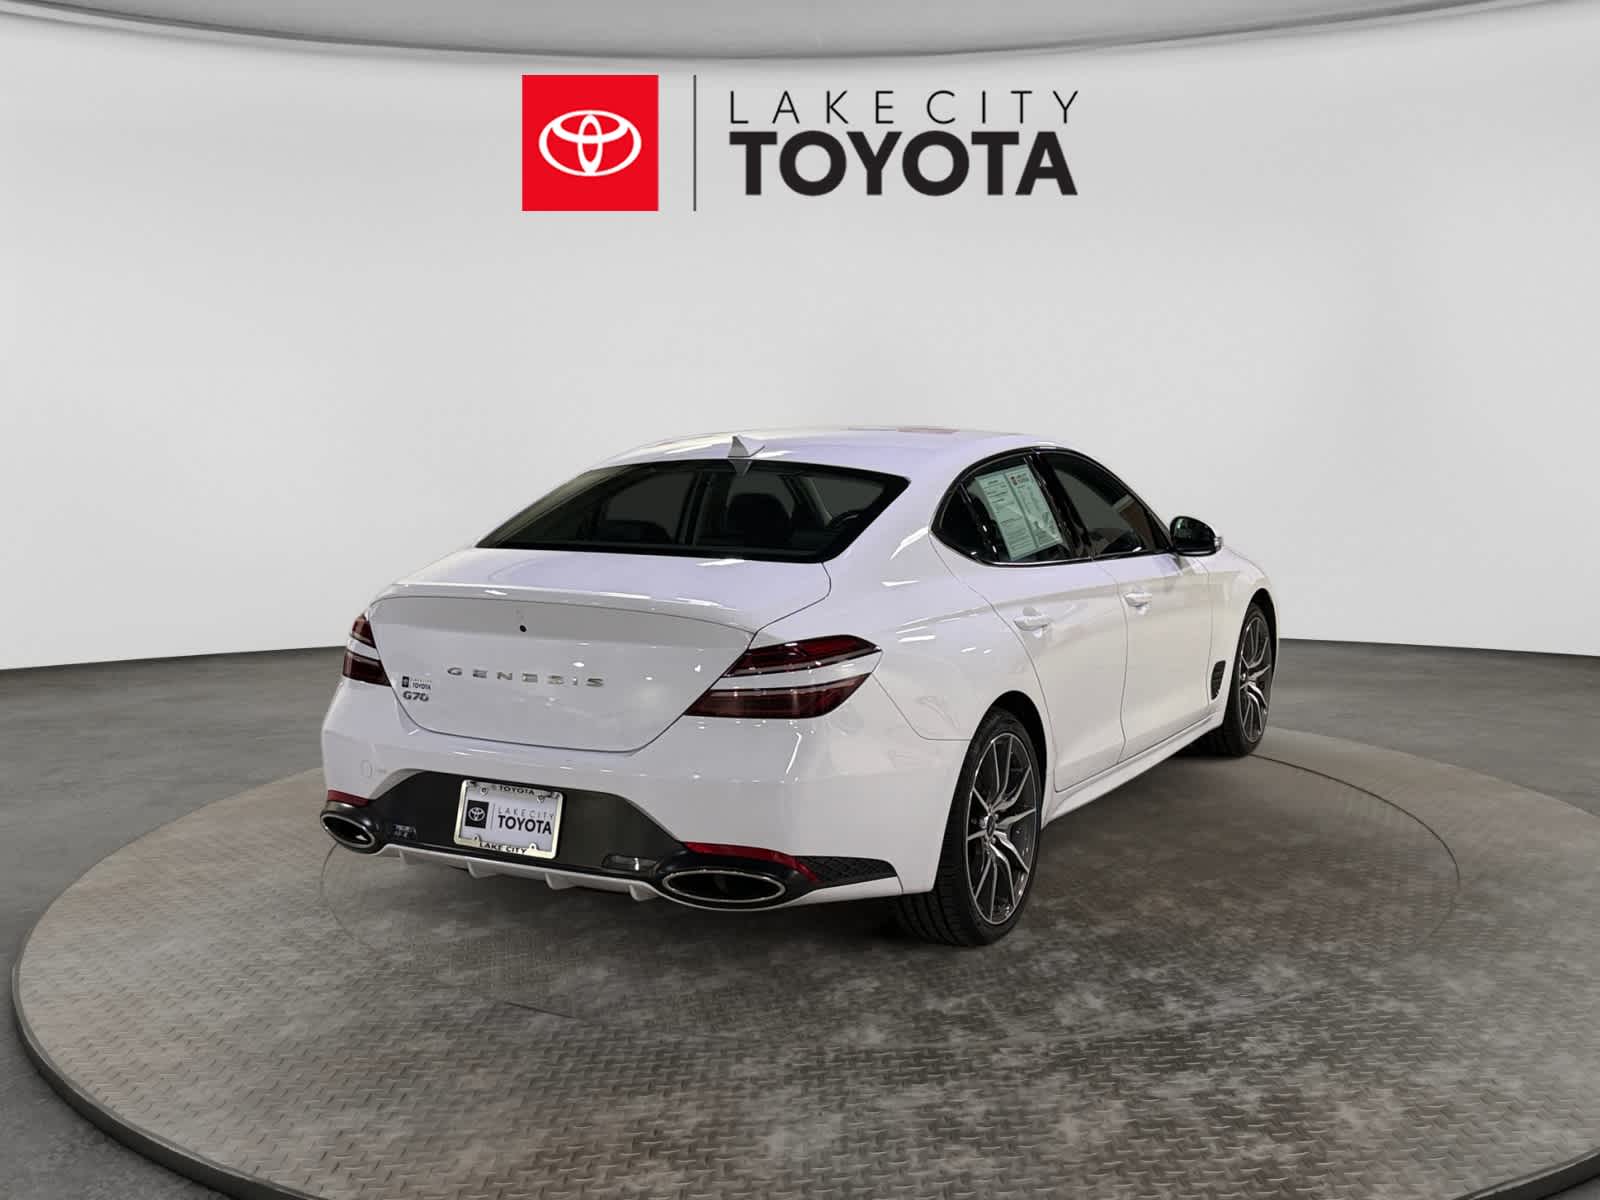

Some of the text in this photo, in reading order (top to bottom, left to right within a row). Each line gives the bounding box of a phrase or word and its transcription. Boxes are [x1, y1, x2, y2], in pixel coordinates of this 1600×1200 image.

[447, 667, 605, 688] GENESIS
[402, 691, 429, 702] G70
[499, 785, 535, 796] TOYOTA
[498, 807, 554, 821] LAKE CITY
[497, 815, 552, 835] TOYOTA
[479, 842, 527, 854] LAKE CITY
